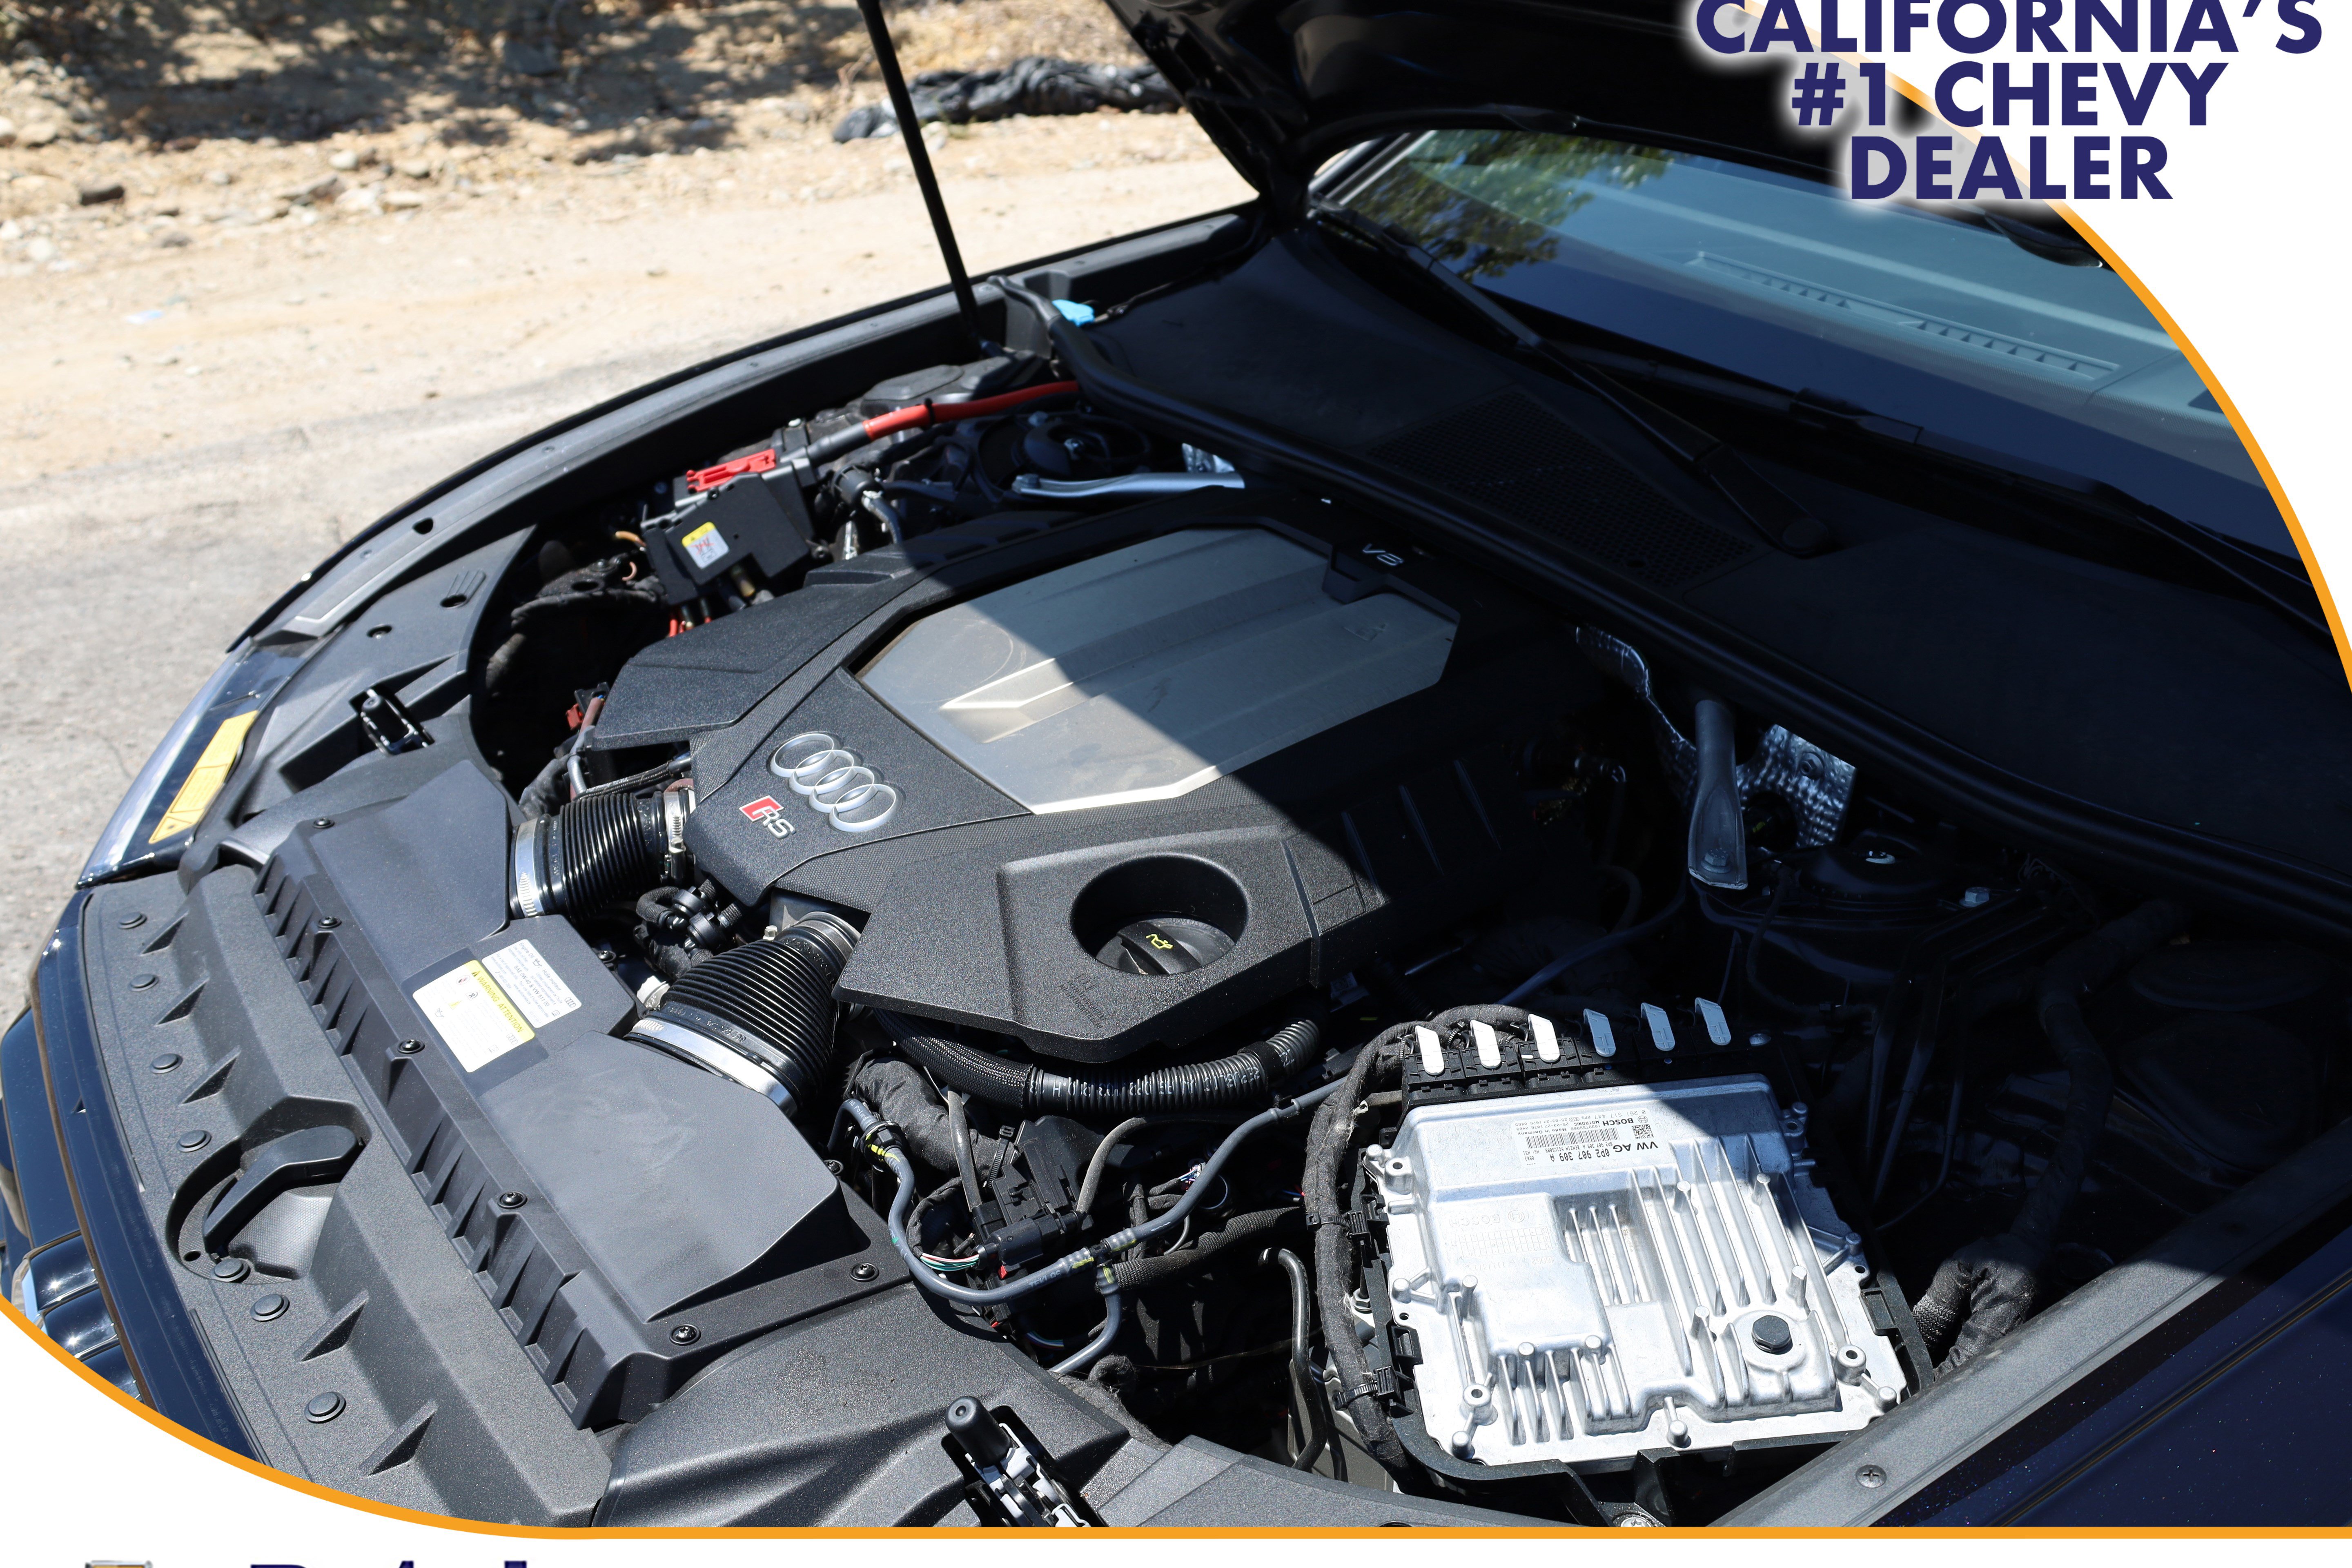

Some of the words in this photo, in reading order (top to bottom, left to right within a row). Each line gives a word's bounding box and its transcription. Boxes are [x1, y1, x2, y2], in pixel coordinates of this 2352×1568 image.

[1362, 543, 1404, 566] V6
[749, 802, 796, 839] RS
[518, 943, 530, 953] Engine
[520, 973, 531, 984] 0W-40
[549, 978, 561, 990] moteur
[476, 977, 500, 1001] WARNING
[496, 1003, 524, 1032] ATTENTION
[1613, 1144, 1632, 1152] AG
[1636, 1141, 1658, 1150] VW
[1549, 1154, 1555, 1162] A
[1559, 1152, 1573, 1161] 309
[1577, 1150, 1591, 1159] 907
[1595, 1148, 1609, 1158] 0P2
[1448, 1215, 1501, 1226] BOSCH
